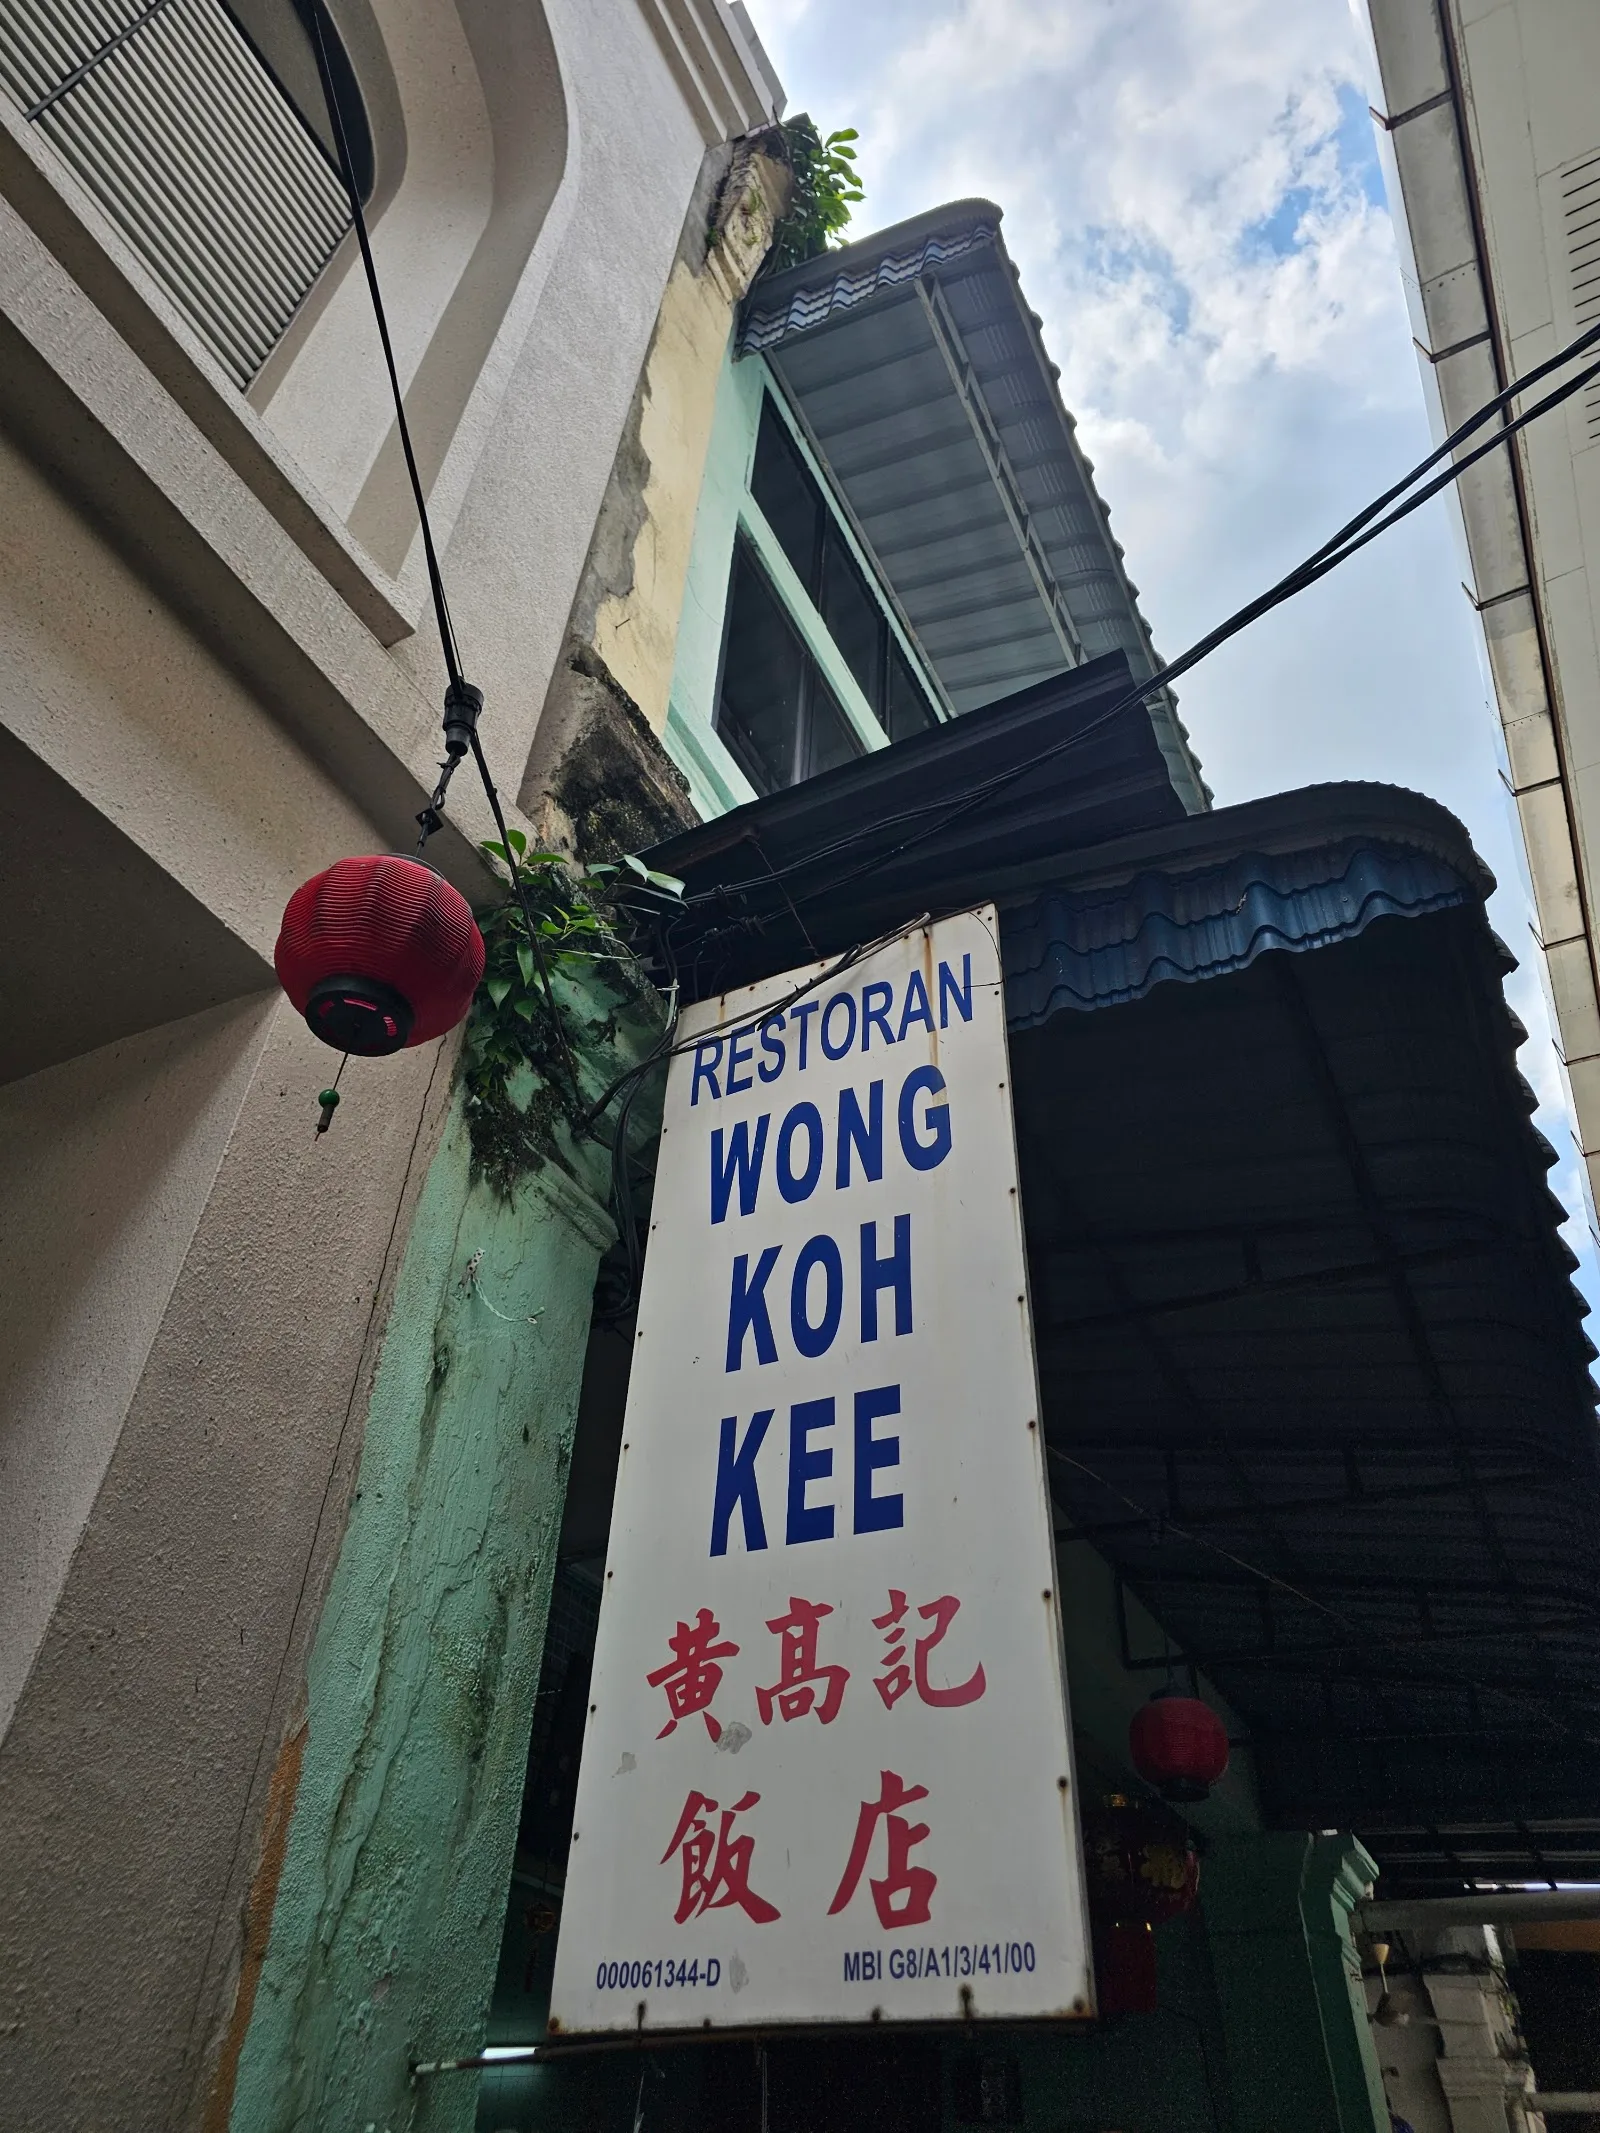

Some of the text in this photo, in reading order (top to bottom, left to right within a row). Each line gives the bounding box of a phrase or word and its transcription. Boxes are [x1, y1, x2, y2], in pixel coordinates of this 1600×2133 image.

[690, 953, 973, 1107] RESTORAN
[710, 1065, 953, 1225] WONG
[726, 1214, 913, 1373] KOH
[710, 1385, 904, 1557] KEE
[660, 1770, 938, 1930] 飯店
[596, 1957, 722, 1990] 000061344-D
[843, 1941, 1037, 1983] MBI G8/A1/3/41/00
